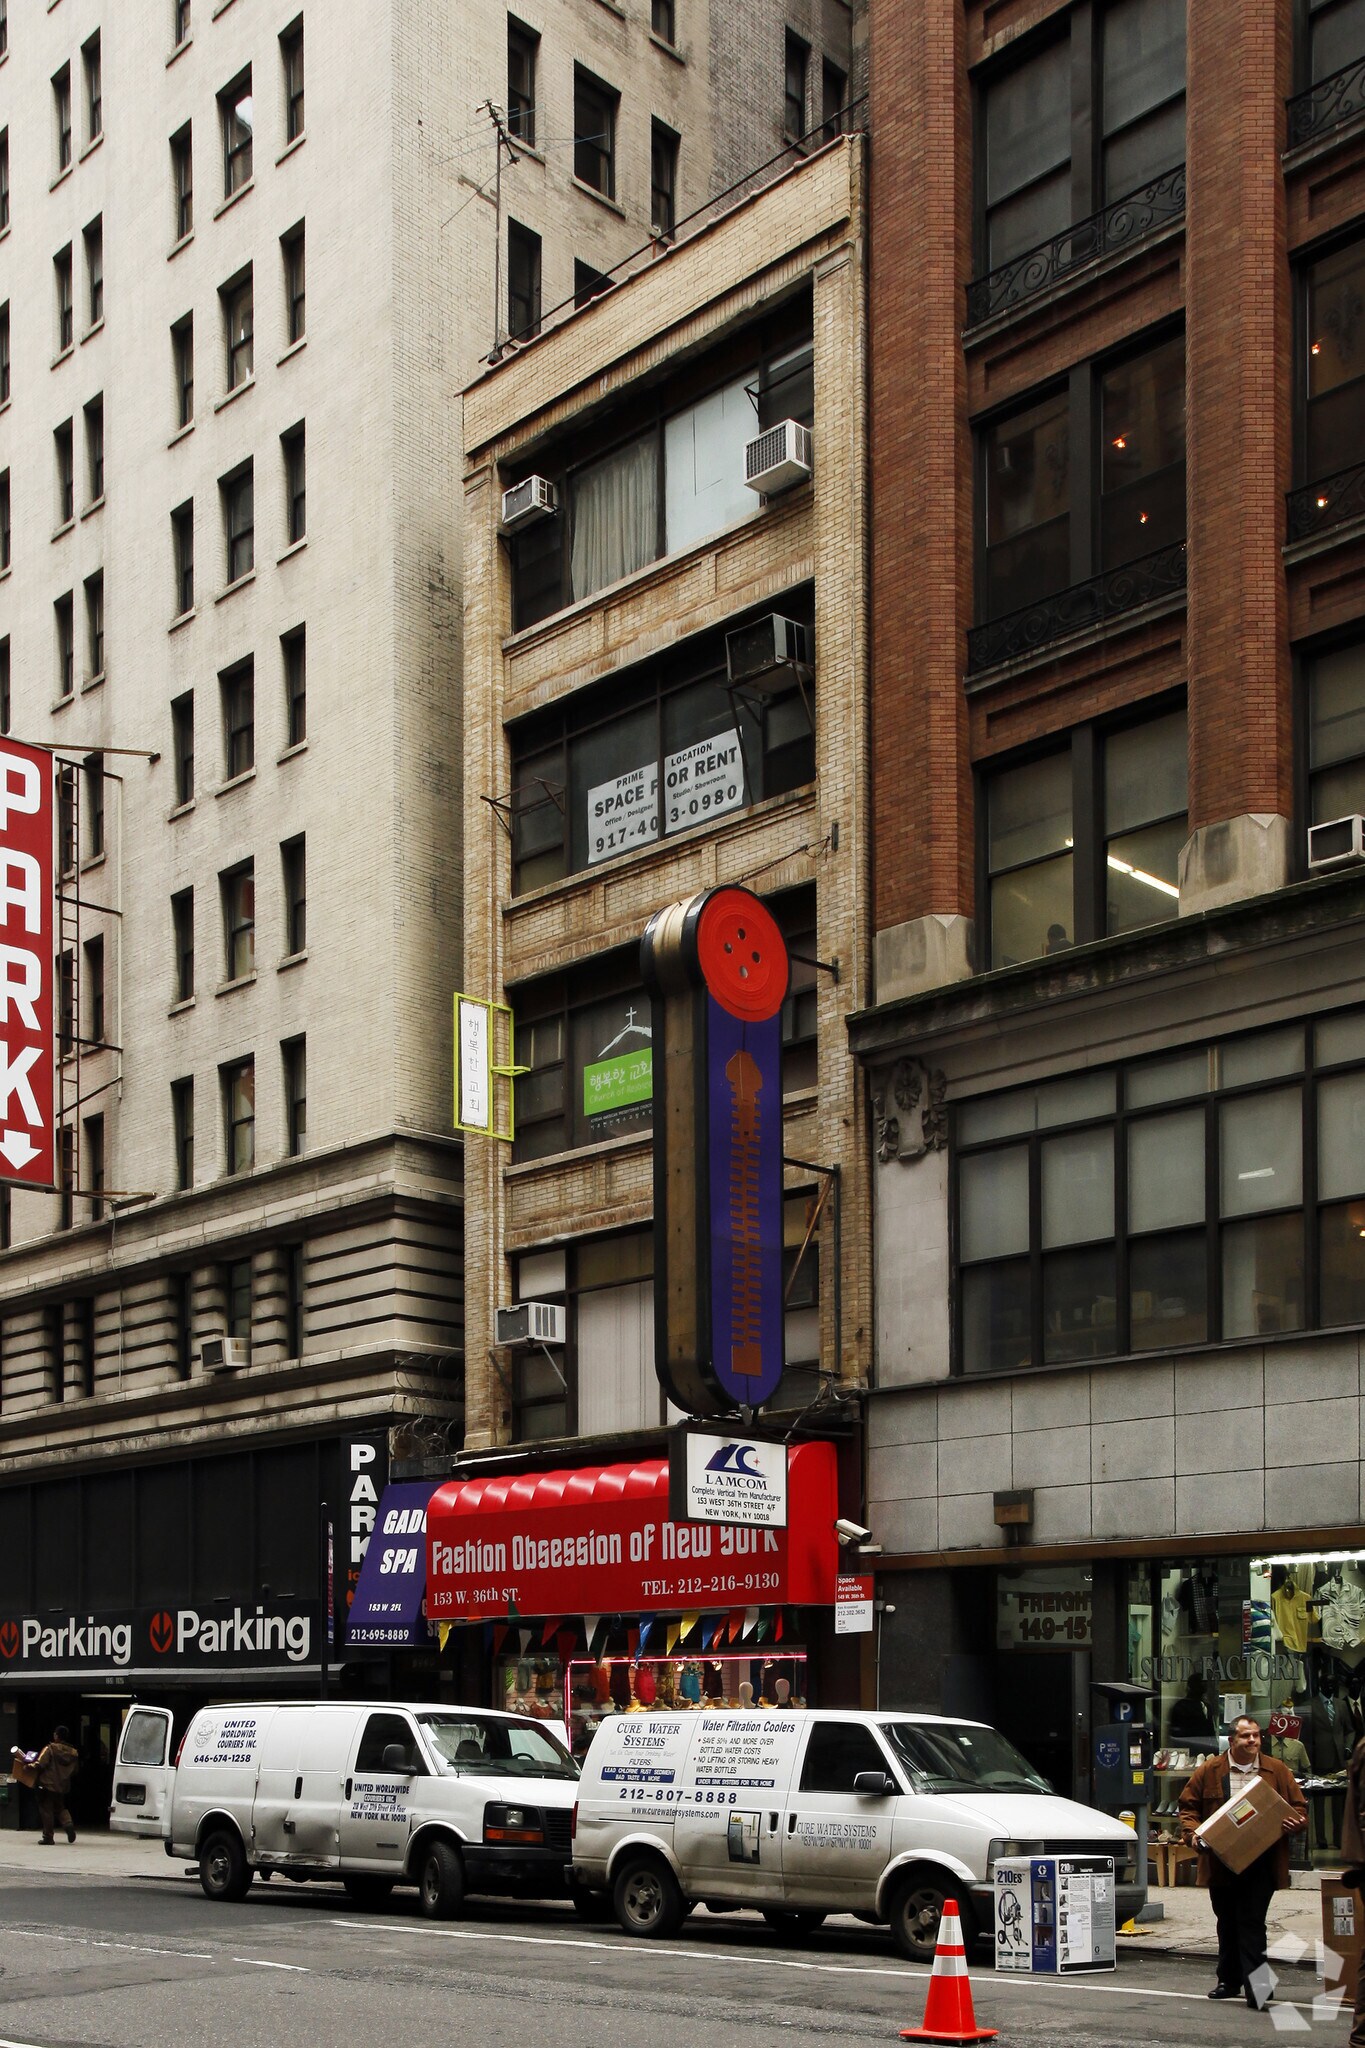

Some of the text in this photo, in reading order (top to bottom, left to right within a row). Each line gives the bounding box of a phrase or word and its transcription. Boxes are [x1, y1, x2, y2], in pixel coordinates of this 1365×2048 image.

[616, 742, 713, 789] PRIME LOCATION
[594, 784, 645, 818] SPACE
[694, 747, 738, 777] RENT
[627, 803, 654, 818] Designer
[694, 774, 726, 790] Showroom
[0, 750, 45, 1128] PARK
[706, 1474, 768, 1490] LAMCOM
[692, 1486, 781, 1502] Complete Vertical Trim Manufacturer
[350, 1444, 378, 1563] PARK
[698, 1497, 776, 1512] 153 WEST 36TH STREET 4/F
[706, 1508, 719, 1516] NEW
[722, 1510, 741, 1519] YORK,
[754, 1512, 770, 1521] 10018
[383, 1509, 427, 1535] GAD
[432, 1538, 506, 1576] Fashion
[512, 1529, 622, 1571] Obsession
[630, 1523, 656, 1562] of
[662, 1522, 712, 1560] New
[380, 1548, 418, 1574] SPA
[642, 1572, 780, 1596] TEL: 212-216-9130
[838, 1584, 862, 1592] Available
[434, 1587, 521, 1606] 153 W. 36th ST.
[368, 1603, 402, 1612] 153 W 2FL
[22, 1606, 310, 1666] Parking Parking
[351, 1629, 410, 1640] 212-695-8889
[1140, 1653, 1300, 1682] SUIT FACTORY
[1120, 1702, 1131, 1720] P
[224, 1720, 256, 1728] UNITED
[616, 1722, 681, 1734] CURE WATER
[702, 1720, 796, 1733] Water Filtration Coolers
[220, 1730, 257, 1738] WORLDWIDE
[624, 1735, 666, 1746] SYSTEMS
[217, 1740, 257, 1748] COURIERS INC.
[760, 1738, 774, 1746] OVER
[700, 1746, 723, 1754] BOTTLED
[194, 1754, 252, 1763] 646-674-1258
[708, 1756, 726, 1764] LIFTING
[738, 1757, 760, 1765] STORING
[762, 1758, 780, 1766] HEAVY
[714, 1766, 737, 1774] BOTTLES
[354, 1784, 410, 1794] UNITED WORLDWIDE
[620, 1788, 737, 1804] 212-807-8888
[350, 1811, 362, 1820] NEW
[364, 1812, 380, 1820] YORK
[391, 1814, 406, 1822] 10018
[631, 1806, 720, 1819] www.curewatersystems.com
[796, 1822, 876, 1838] CURE WATER SYSTEMS
[997, 1870, 1022, 1884] 210ES
